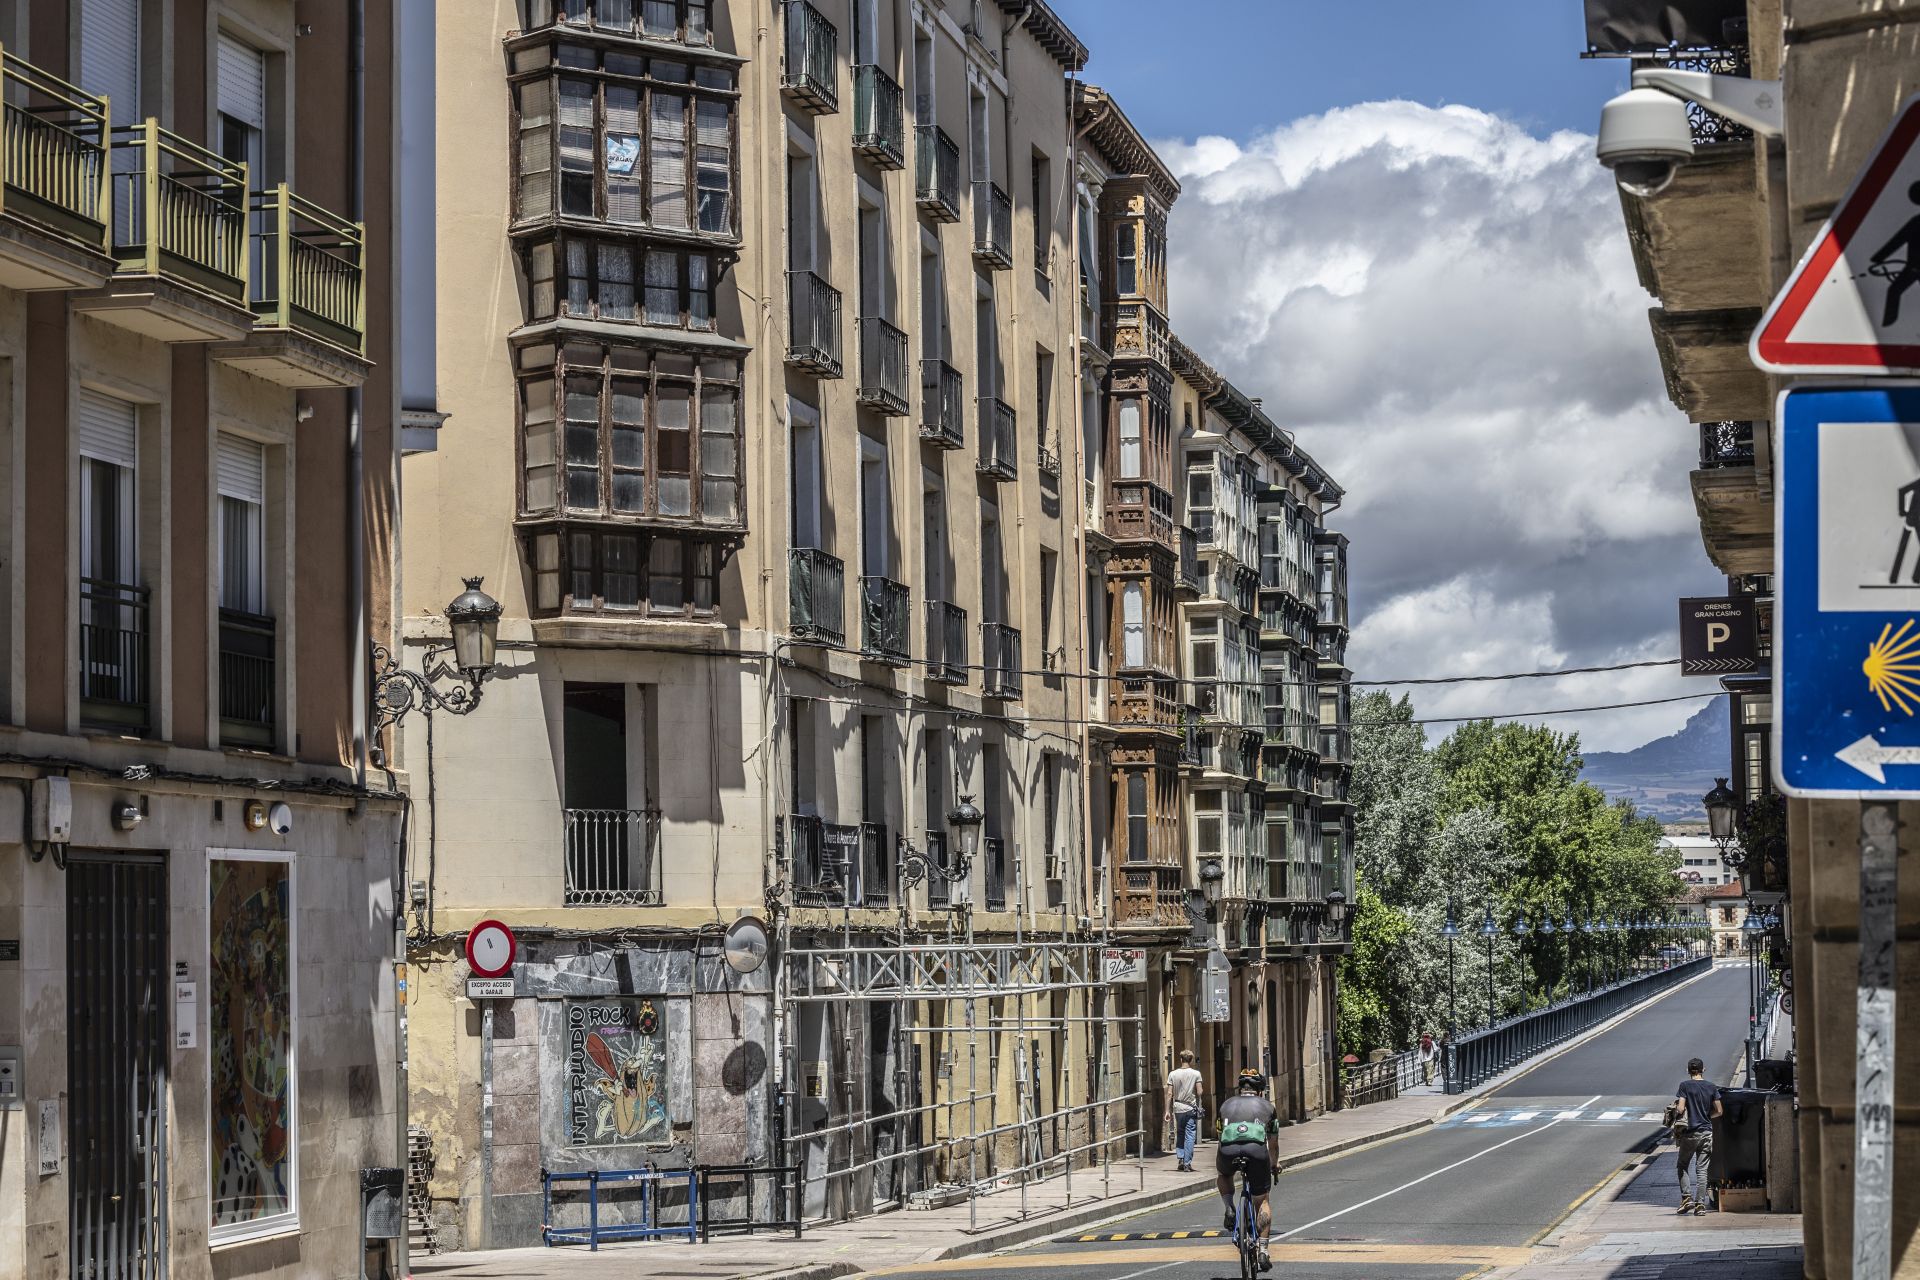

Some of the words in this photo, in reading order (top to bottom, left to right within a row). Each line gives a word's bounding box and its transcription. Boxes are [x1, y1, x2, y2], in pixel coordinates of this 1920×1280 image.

[1694, 610, 1714, 618] GRAN
[1715, 609, 1742, 617] CASINO
[1706, 622, 1731, 653] P
[587, 1006, 631, 1026] ROCK
[569, 1005, 589, 1146] INTERLUDIO
